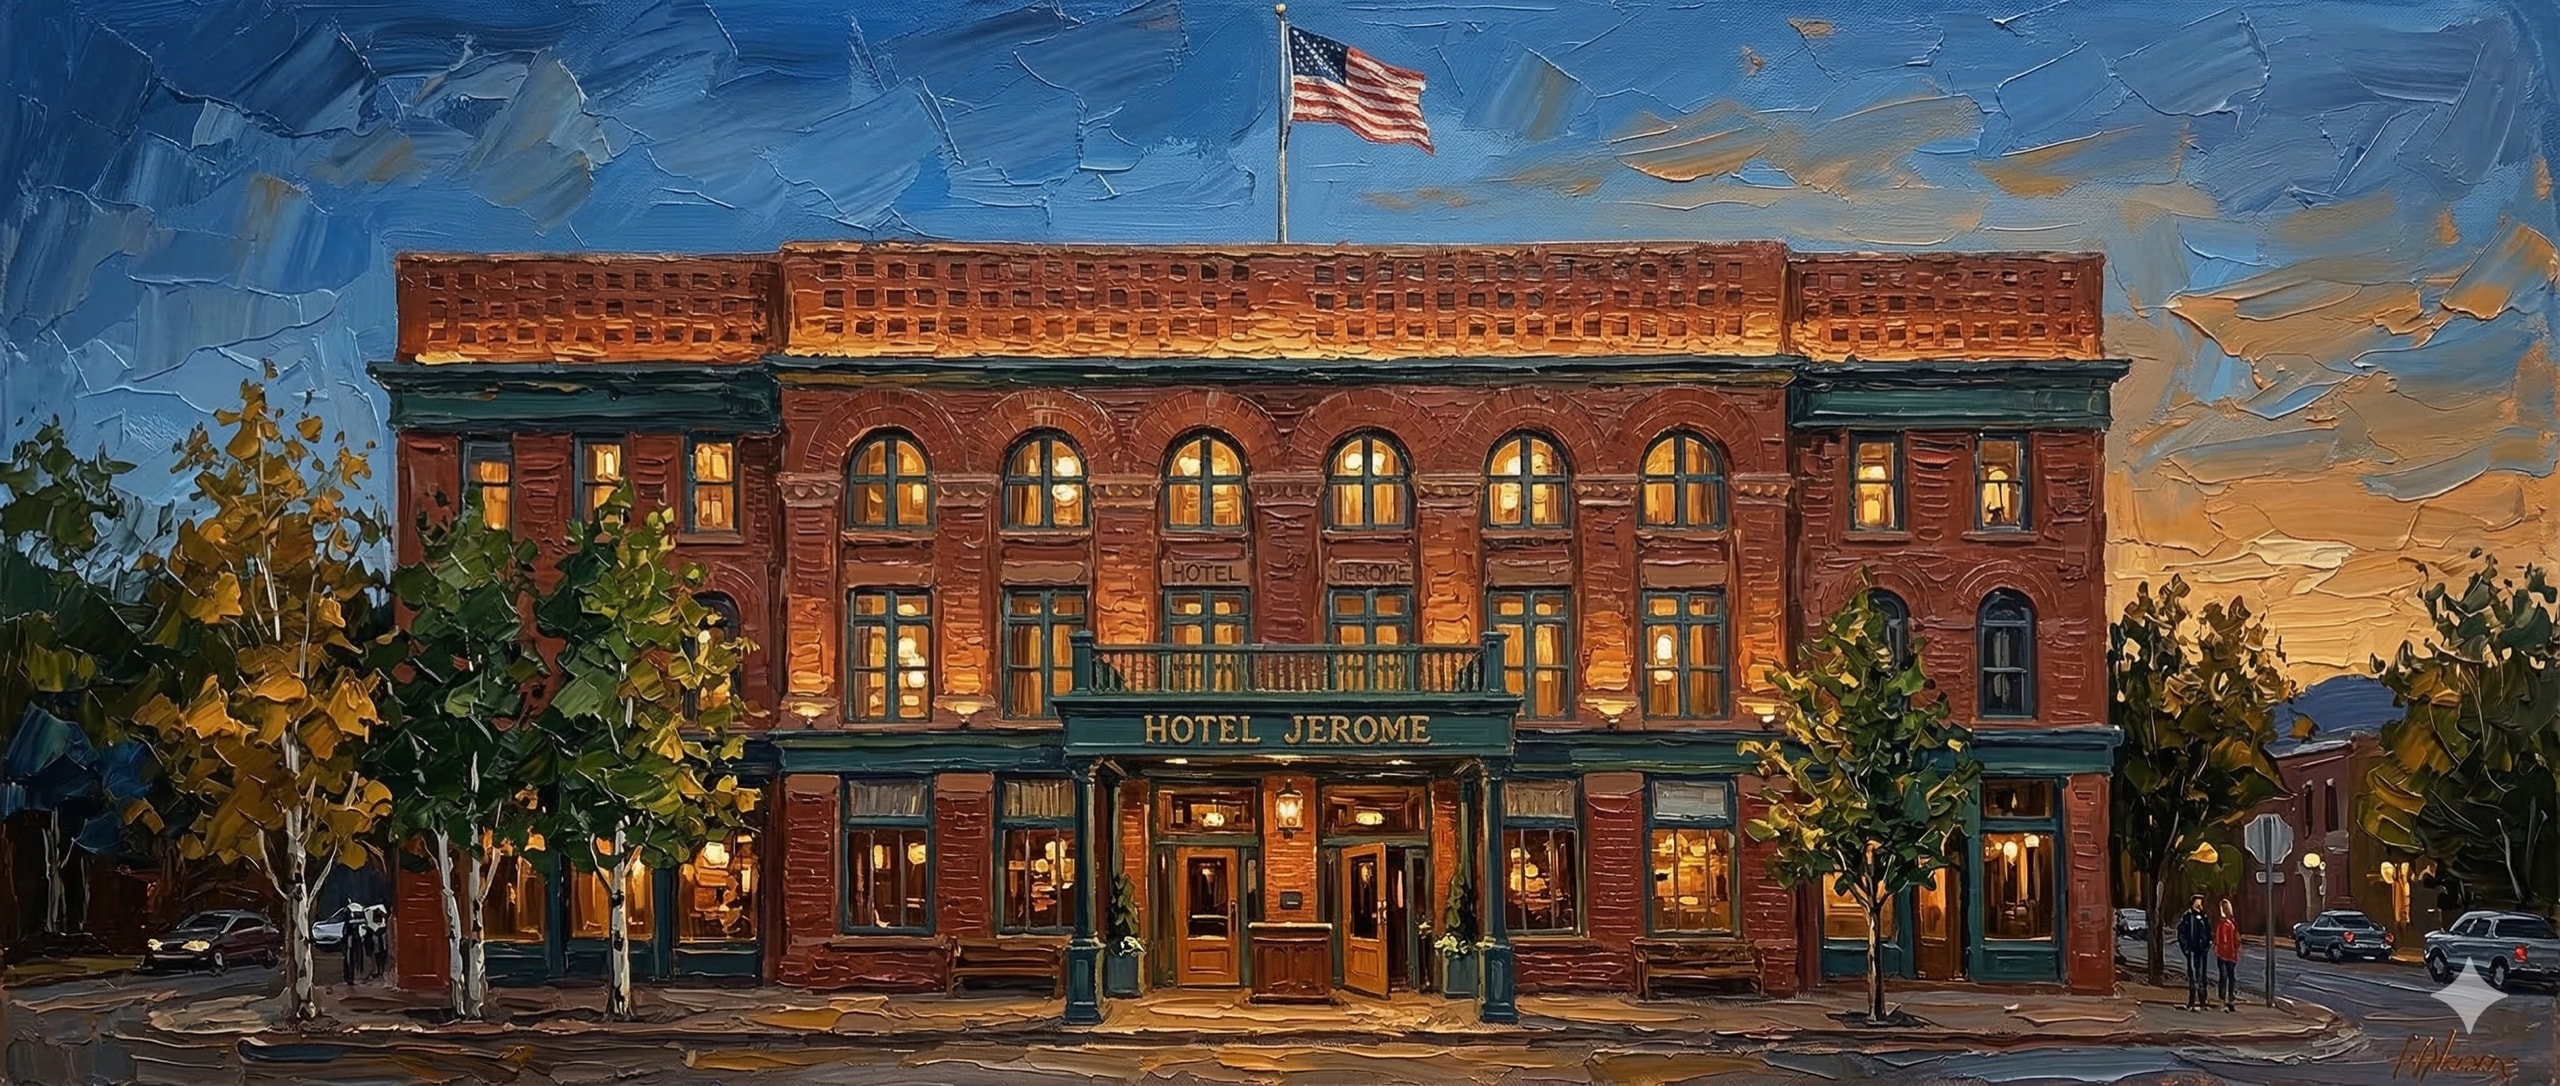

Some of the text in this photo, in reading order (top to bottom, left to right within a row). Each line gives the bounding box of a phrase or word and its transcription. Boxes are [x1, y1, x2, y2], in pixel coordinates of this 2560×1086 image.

[1172, 563, 1412, 583] HOTEL JEROME
[1143, 714, 1432, 745] HOTEL JEROME
